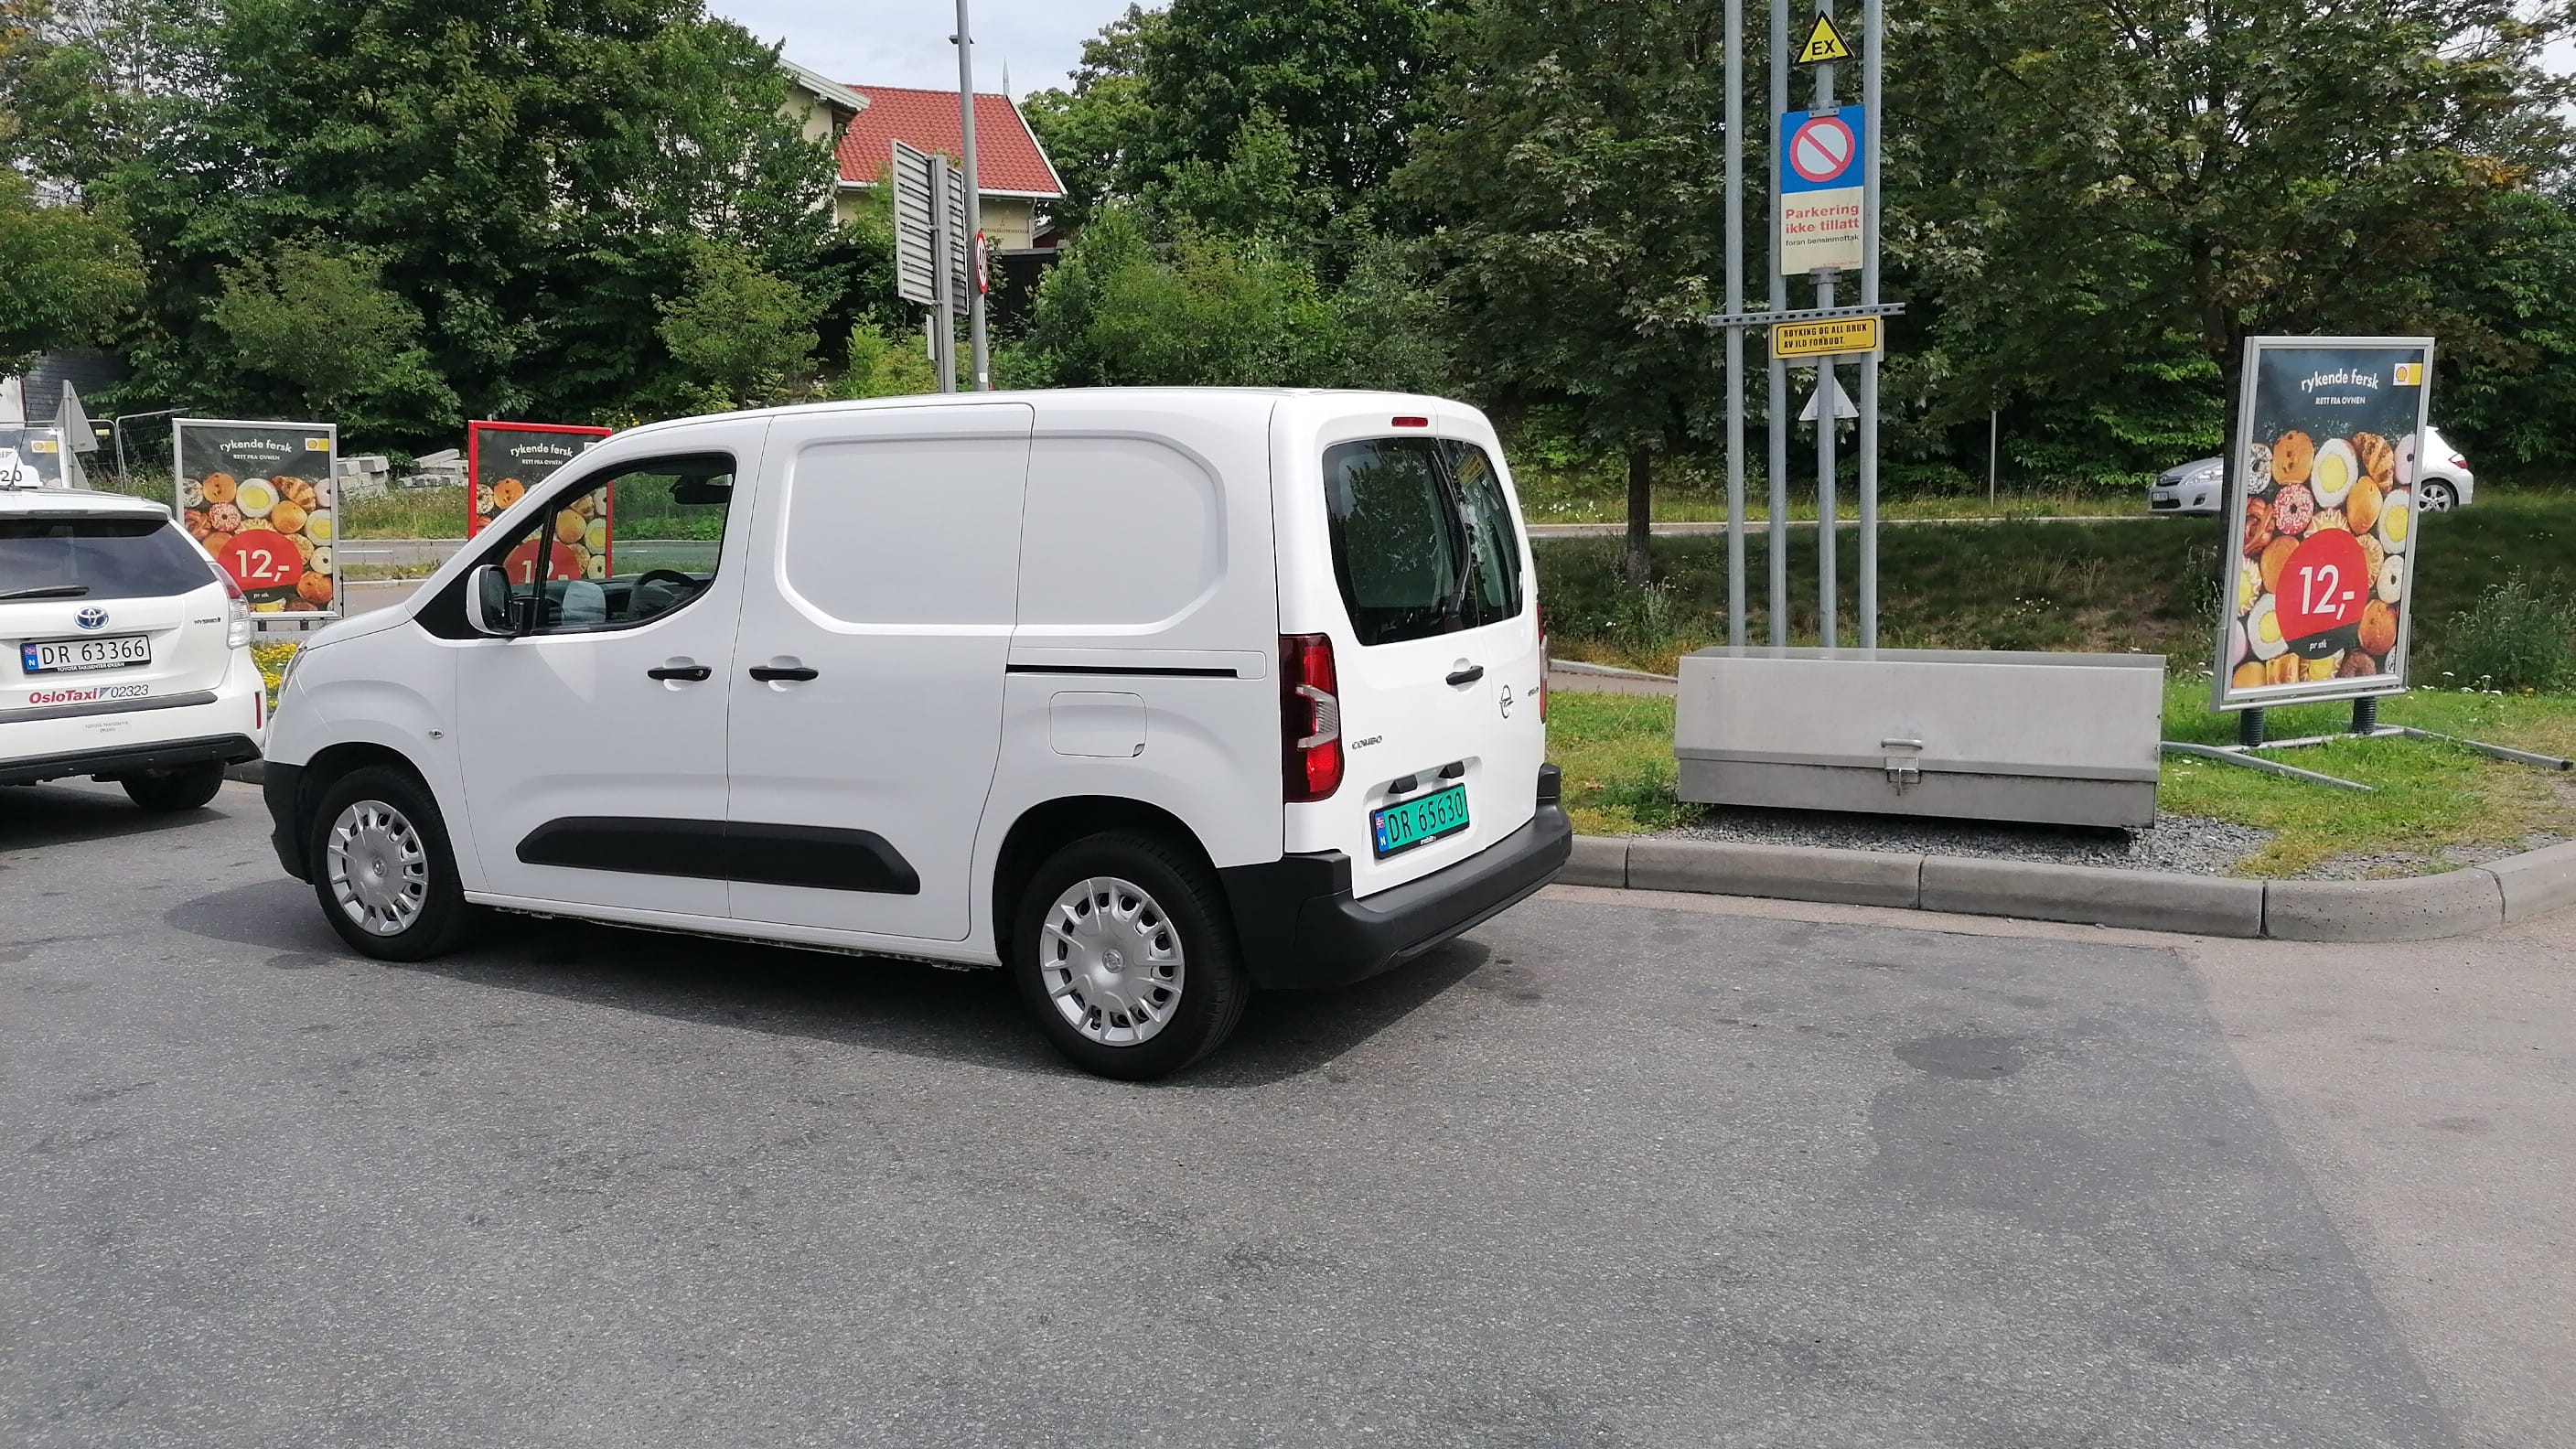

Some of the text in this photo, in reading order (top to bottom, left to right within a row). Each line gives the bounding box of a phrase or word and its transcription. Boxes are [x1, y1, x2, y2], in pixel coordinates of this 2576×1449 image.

[1811, 38, 1836, 56] EX
[1786, 204, 1860, 220] Parkering
[1785, 218, 1860, 234] ikke tillatt
[1819, 326, 1830, 336] OG
[1831, 325, 1843, 334] ALL
[1846, 323, 1867, 333] BRUK
[1784, 340, 1793, 349] AV
[1795, 339, 1808, 348] ILD
[2301, 368, 2379, 393] rykende fersk
[2314, 396, 2366, 405] RETT FRA OVNEN
[220, 438, 293, 453] rykende fersk
[510, 443, 574, 457] rykende fersk
[235, 549, 290, 583] 12,-
[2299, 564, 2356, 621] 12,-
[42, 645, 71, 665] DR
[81, 639, 145, 661] 63366
[28, 684, 149, 704] OsloTaxi 02323
[1379, 791, 1464, 846] N DR 65630
